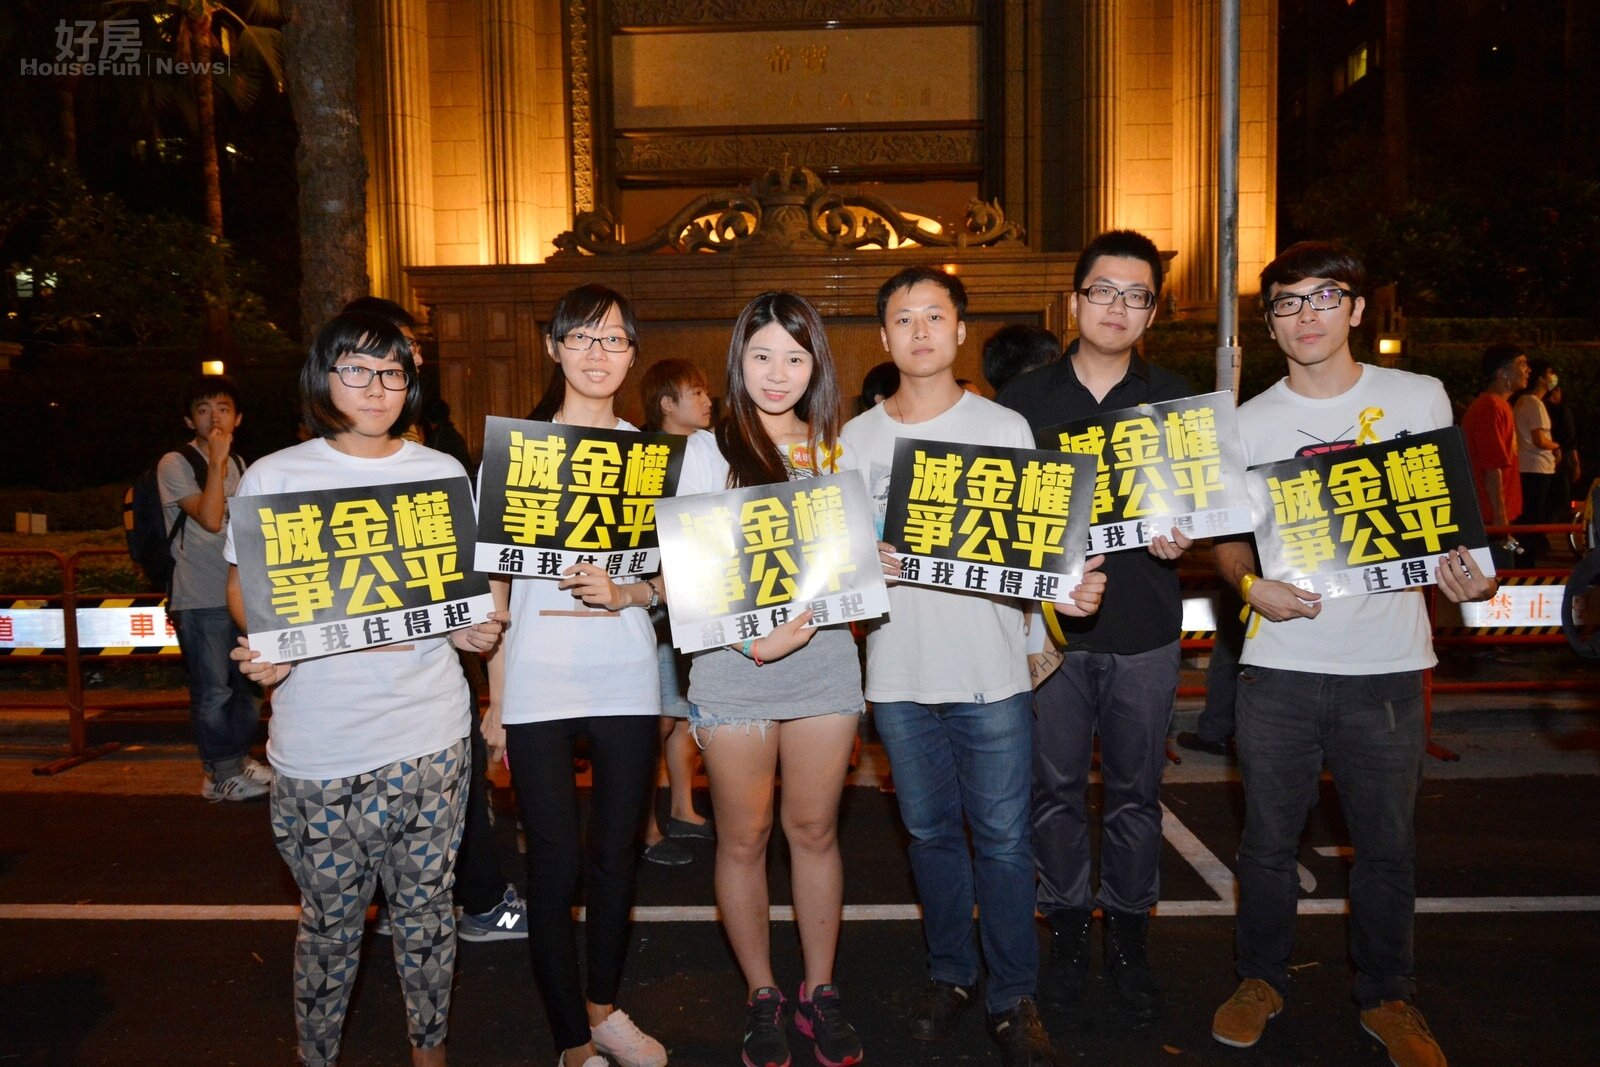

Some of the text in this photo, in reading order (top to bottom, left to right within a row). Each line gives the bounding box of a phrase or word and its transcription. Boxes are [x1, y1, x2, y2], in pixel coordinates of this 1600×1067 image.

[505, 431, 671, 496] 滅金權
[908, 450, 1075, 517] 滅金權
[1266, 443, 1450, 526] 滅金權
[257, 491, 457, 566] 滅金權
[502, 489, 656, 550] 爭公平
[678, 485, 849, 556] 滅金權
[903, 503, 1068, 569] 爭公平
[1278, 497, 1459, 574] 爭公平
[267, 545, 464, 626] 爭公平
[898, 556, 1060, 600] 給我住得起
[1487, 592, 1552, 620] 禁止
[277, 602, 473, 659] 給我住得起
[496, 911, 521, 930] N
